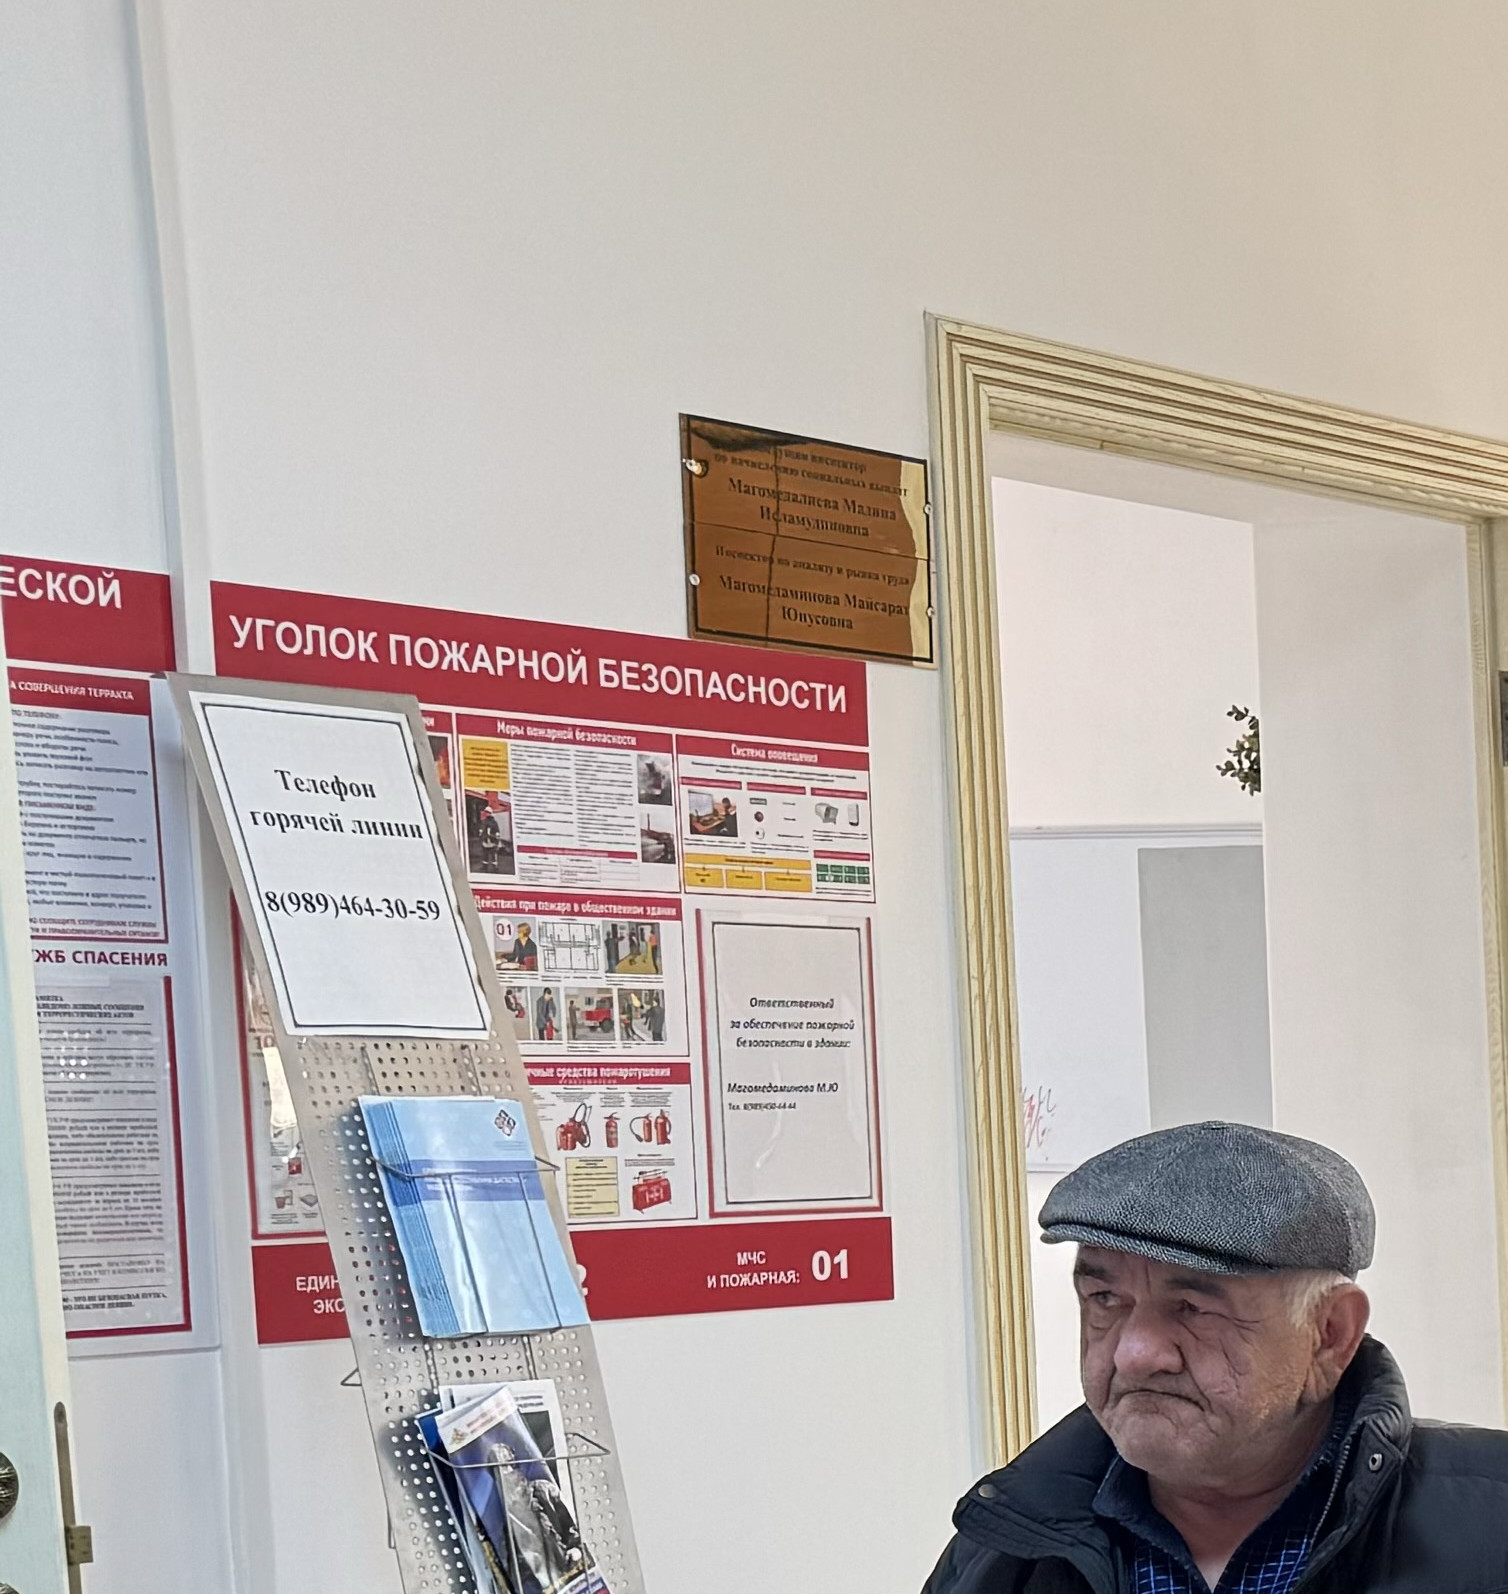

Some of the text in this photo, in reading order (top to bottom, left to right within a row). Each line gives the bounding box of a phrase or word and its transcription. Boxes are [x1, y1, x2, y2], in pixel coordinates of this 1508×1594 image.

[782, 605, 853, 629] Юнусовна
[228, 614, 847, 713] УГОЛОК ПОЖАРНОЙ БЕЗОПАСНОСТИ
[273, 769, 377, 802] Телефон
[249, 810, 424, 839] горячей линии
[264, 890, 441, 921] 8(989)464-30-59
[32, 949, 168, 966] ЖБ СПАСЕНИЯ
[750, 997, 835, 1009] Ответственный
[730, 1018, 855, 1032] за обеспечение пожарной
[556, 1067, 598, 1081] средства
[736, 1250, 766, 1266] МЧС
[811, 1249, 849, 1282] 01
[707, 1271, 801, 1289] И ПОЖАРНАЯ:
